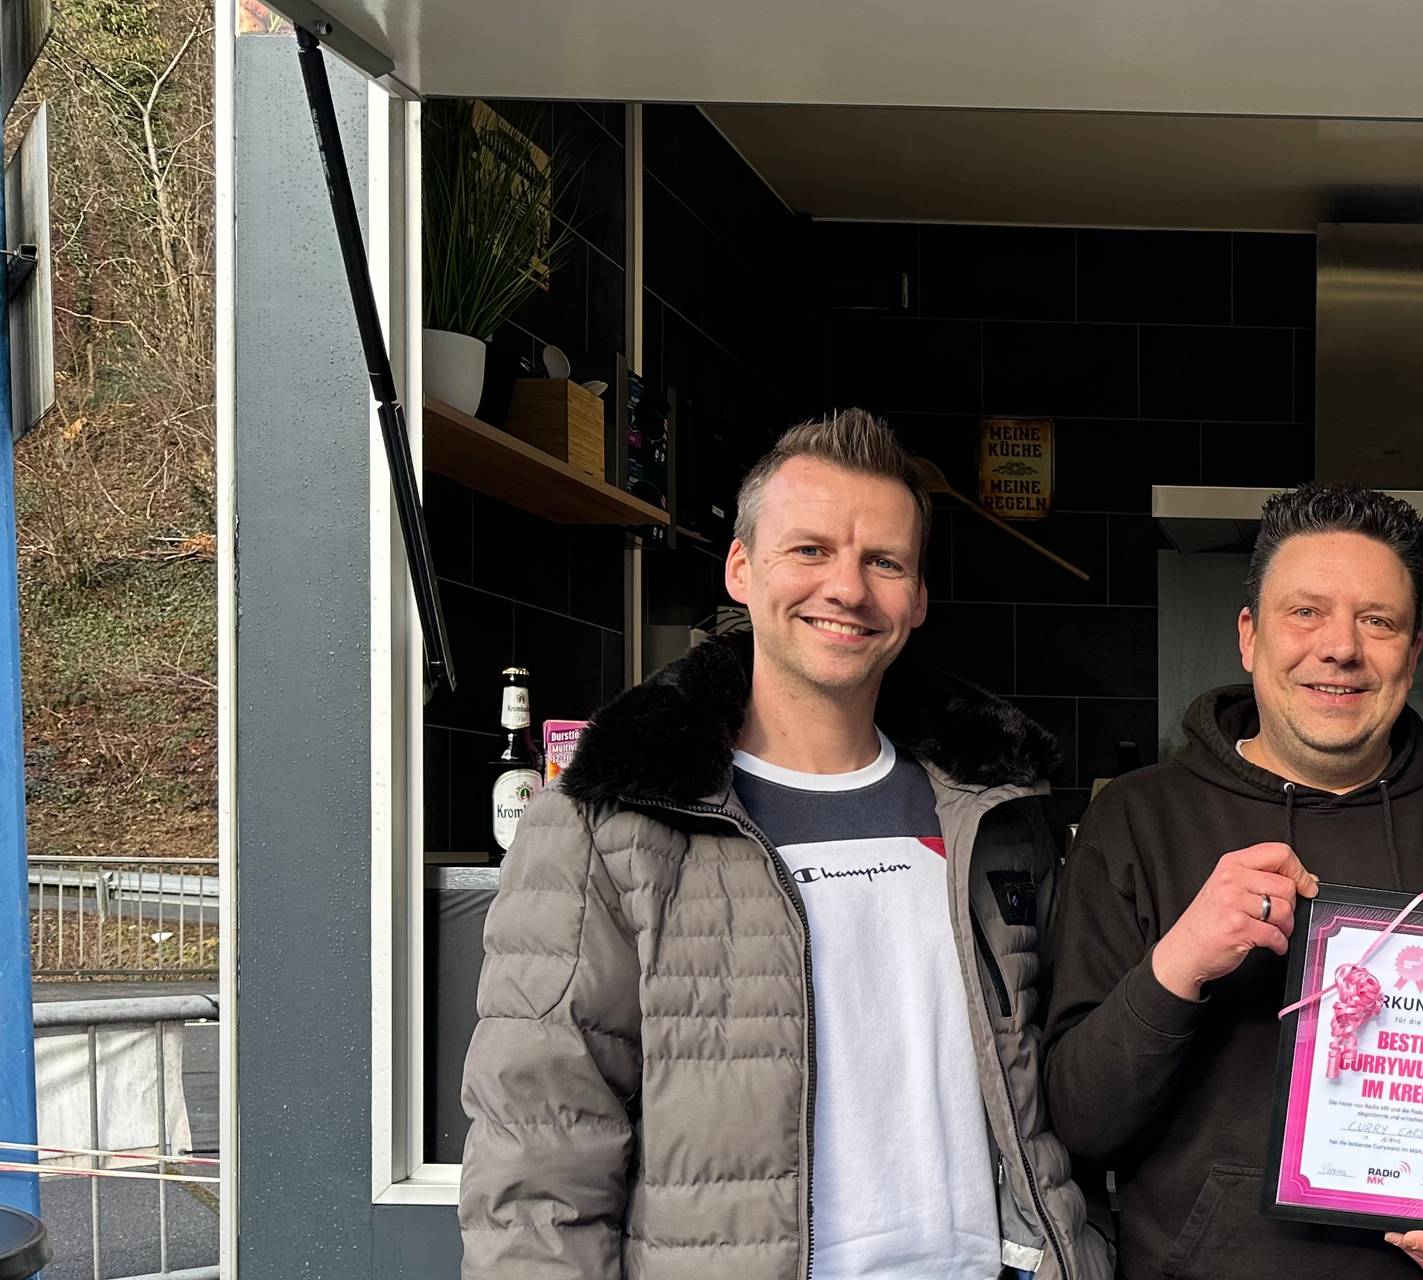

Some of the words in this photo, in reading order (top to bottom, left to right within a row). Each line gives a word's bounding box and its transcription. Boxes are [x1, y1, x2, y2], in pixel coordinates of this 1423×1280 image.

[990, 426, 1040, 441] MEINE
[988, 440, 1042, 457] KÜCHE
[990, 480, 1041, 494] MEINE
[984, 496, 1047, 511] REGELN
[496, 804, 527, 819] Krom
[792, 862, 911, 884] Champion
[1394, 1016, 1406, 1025] für
[1409, 1018, 1422, 1026] die
[1361, 1079, 1384, 1099] IM
[1367, 1176, 1385, 1185] MK
[1368, 1167, 1400, 1179] RADIO
